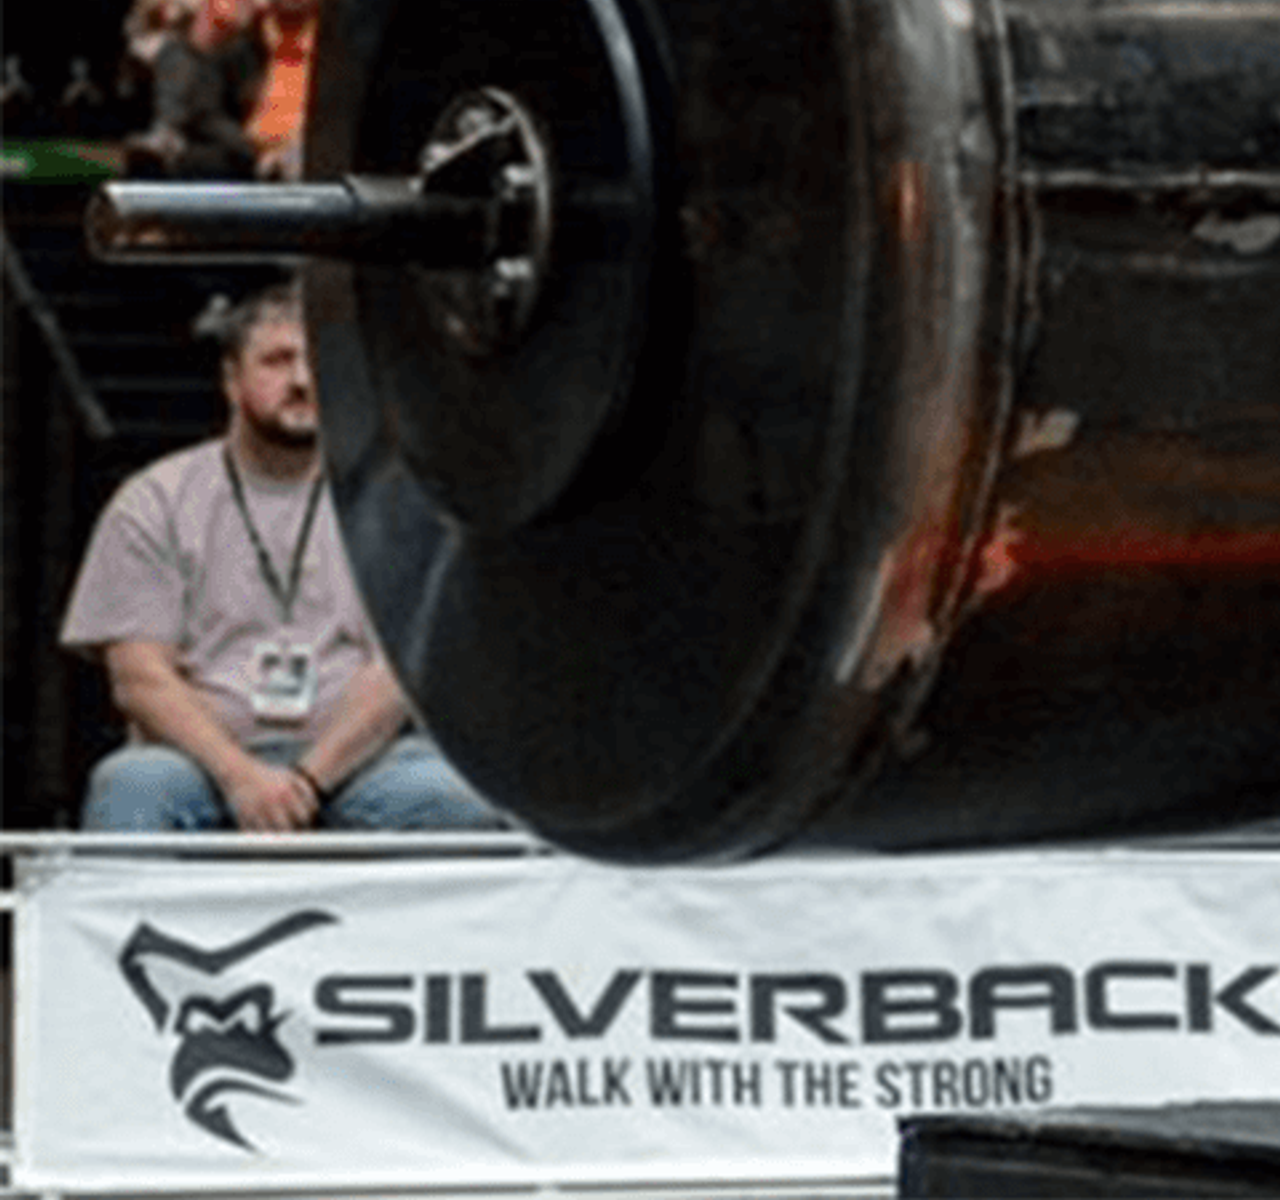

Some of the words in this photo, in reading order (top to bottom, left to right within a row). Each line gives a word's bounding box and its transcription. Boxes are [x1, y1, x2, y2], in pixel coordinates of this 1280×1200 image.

[501, 1060, 631, 1109] WALK
[646, 1059, 762, 1105] WITH
[776, 1061, 858, 1107] THE
[876, 1057, 1054, 1107] STRONG
